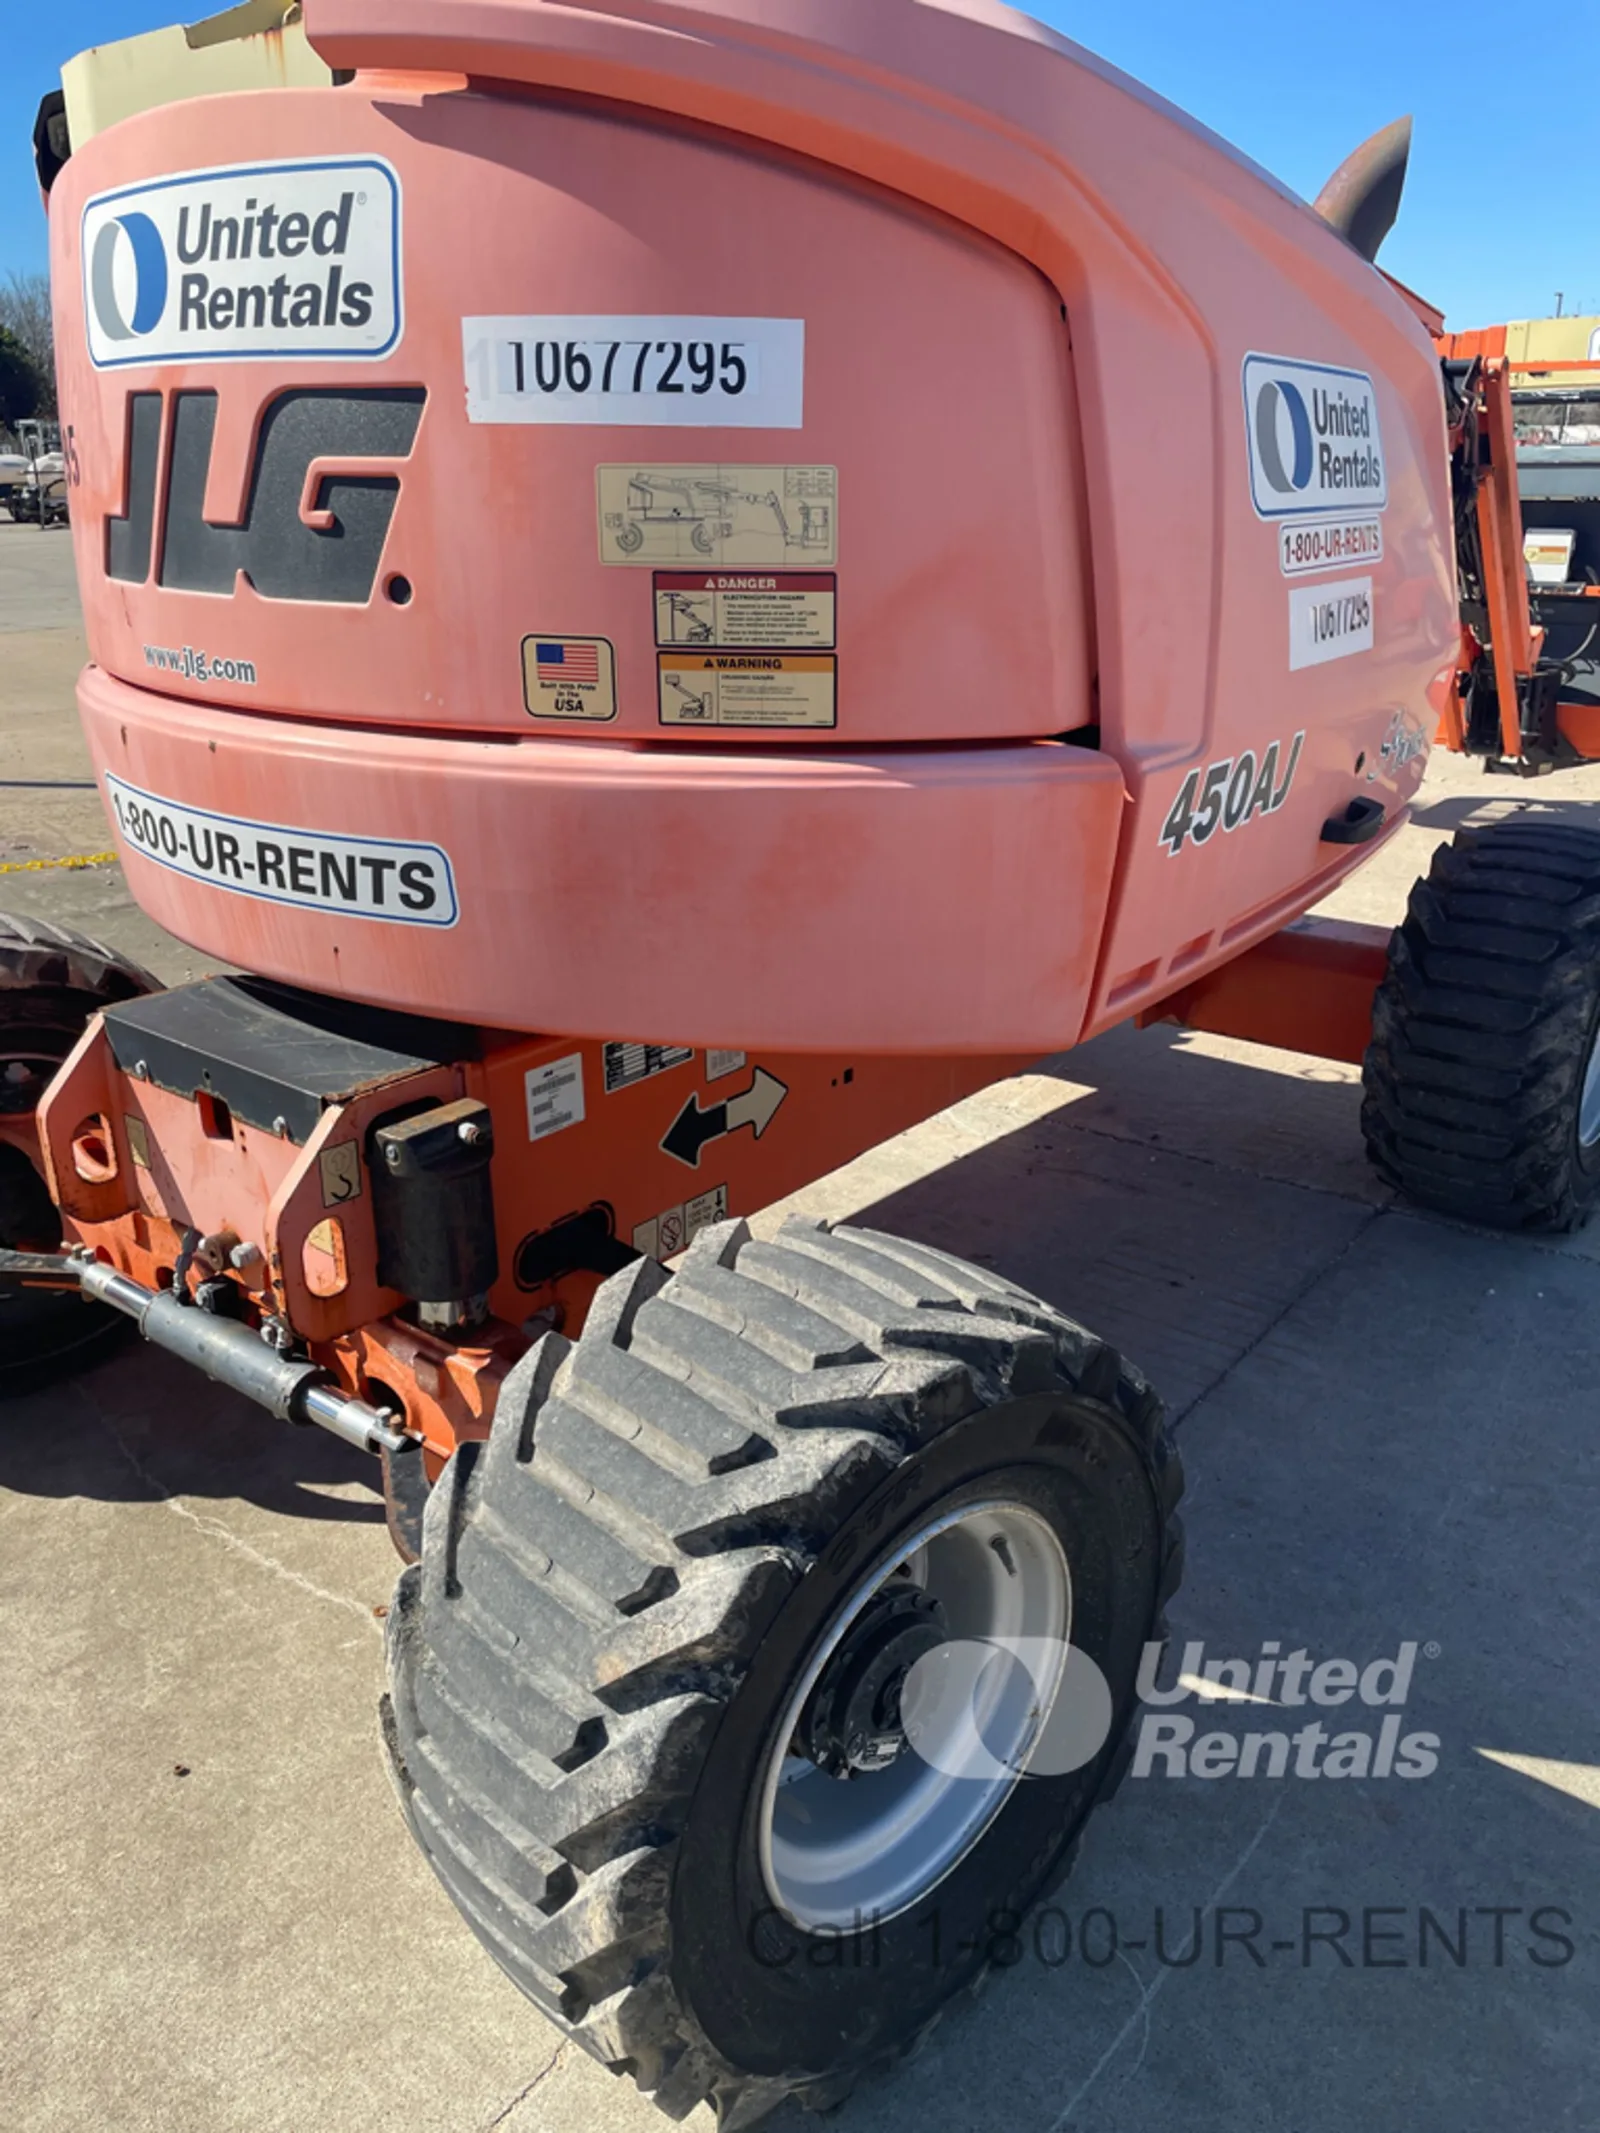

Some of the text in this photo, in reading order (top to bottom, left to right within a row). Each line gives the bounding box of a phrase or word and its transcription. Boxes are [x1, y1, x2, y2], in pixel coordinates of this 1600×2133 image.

[177, 192, 354, 265] United
[179, 265, 374, 332] Rentals
[507, 341, 747, 395] 10677295
[1313, 388, 1370, 438] United
[1319, 441, 1380, 489] Rentals
[104, 383, 429, 607] JLG
[1285, 525, 1379, 564] 1-800-UR-RENTS
[717, 578, 777, 590] DANGER
[1312, 591, 1370, 643] 10677295
[143, 644, 257, 685] www.jlg.com
[716, 658, 782, 670] WARNING
[555, 699, 584, 712] USA
[1159, 731, 1304, 856] 450AJ
[113, 793, 437, 911] 1-800-UR-RENTS
